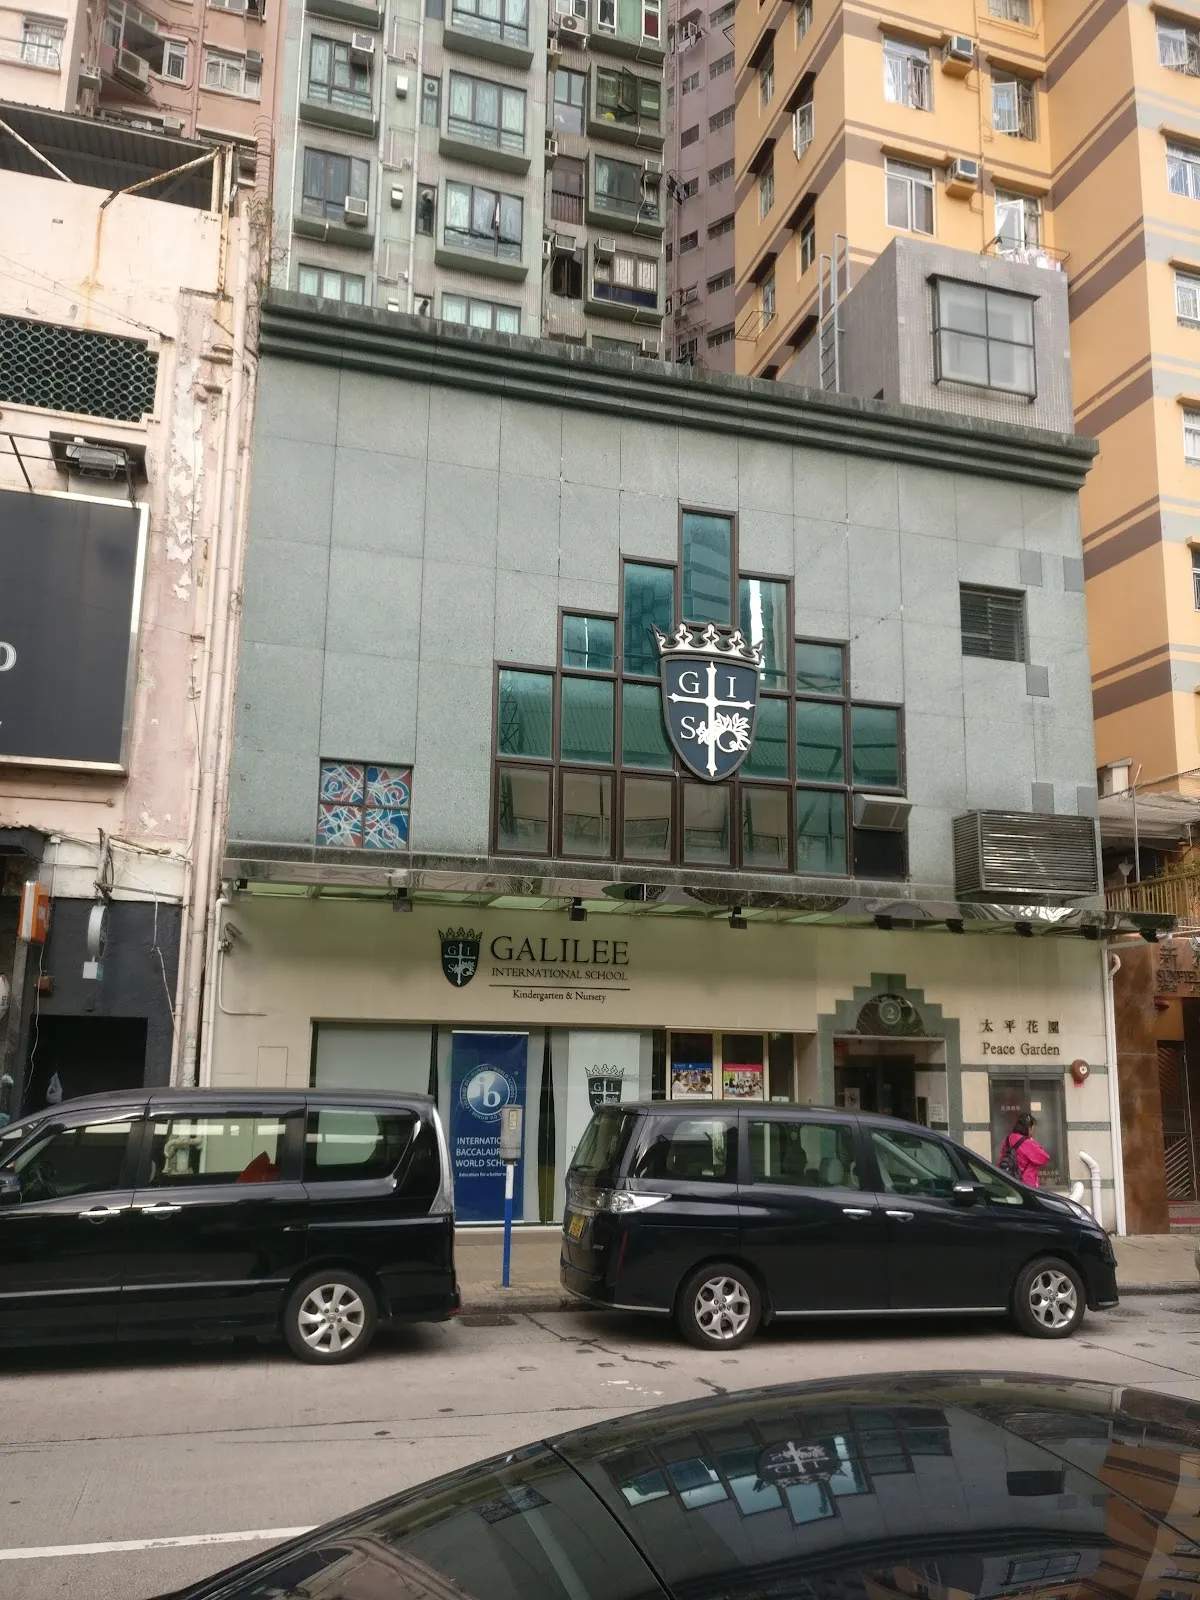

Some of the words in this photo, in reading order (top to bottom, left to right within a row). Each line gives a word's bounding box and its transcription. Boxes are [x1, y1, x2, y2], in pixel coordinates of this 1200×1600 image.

[678, 671, 701, 694] G
[725, 676, 737, 699] I
[680, 716, 696, 739] S
[490, 935, 630, 965] GALILEE
[491, 967, 582, 980] INTERNATIONAL
[585, 970, 629, 982] SCHOOL
[512, 989, 564, 1002] Kindergarten
[565, 991, 574, 1000] &
[575, 991, 607, 1004] Nursery
[982, 1042, 1016, 1055] Peace
[1020, 1043, 1061, 1056] Garden
[457, 1136, 502, 1145] INTERNATIO
[456, 1147, 503, 1157] BACCALAUR
[455, 1159, 485, 1168] WORLD
[486, 1159, 519, 1168] SCHOL
